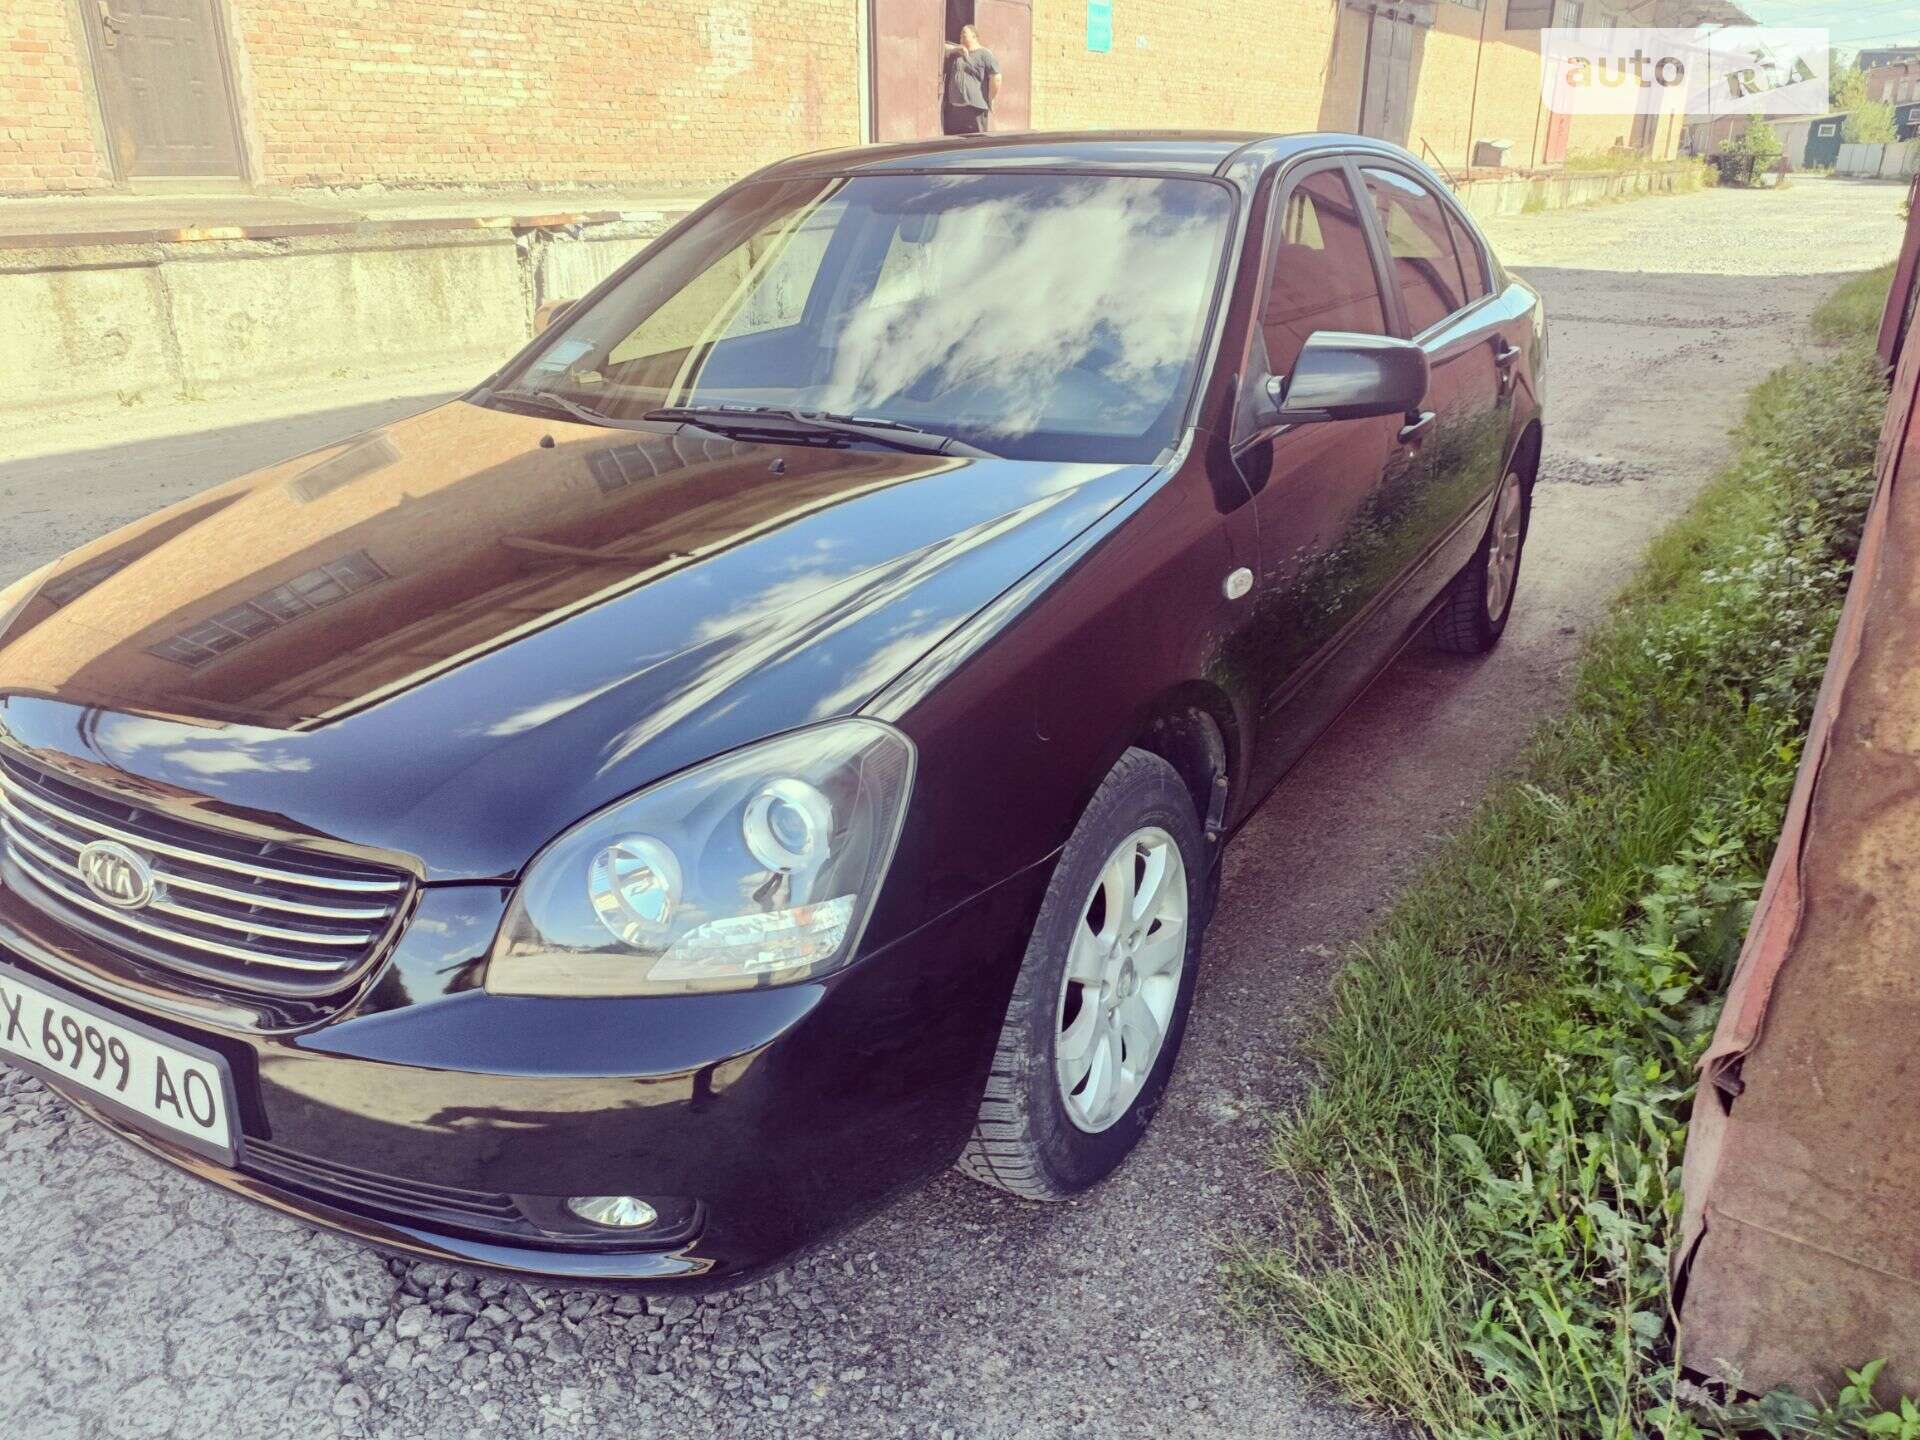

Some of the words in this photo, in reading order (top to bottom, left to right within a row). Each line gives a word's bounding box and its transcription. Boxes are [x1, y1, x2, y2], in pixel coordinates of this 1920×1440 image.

[88, 853, 136, 899] KIA
[0, 987, 32, 1049] X
[42, 1007, 130, 1092] 6999
[155, 1055, 216, 1128] AO
